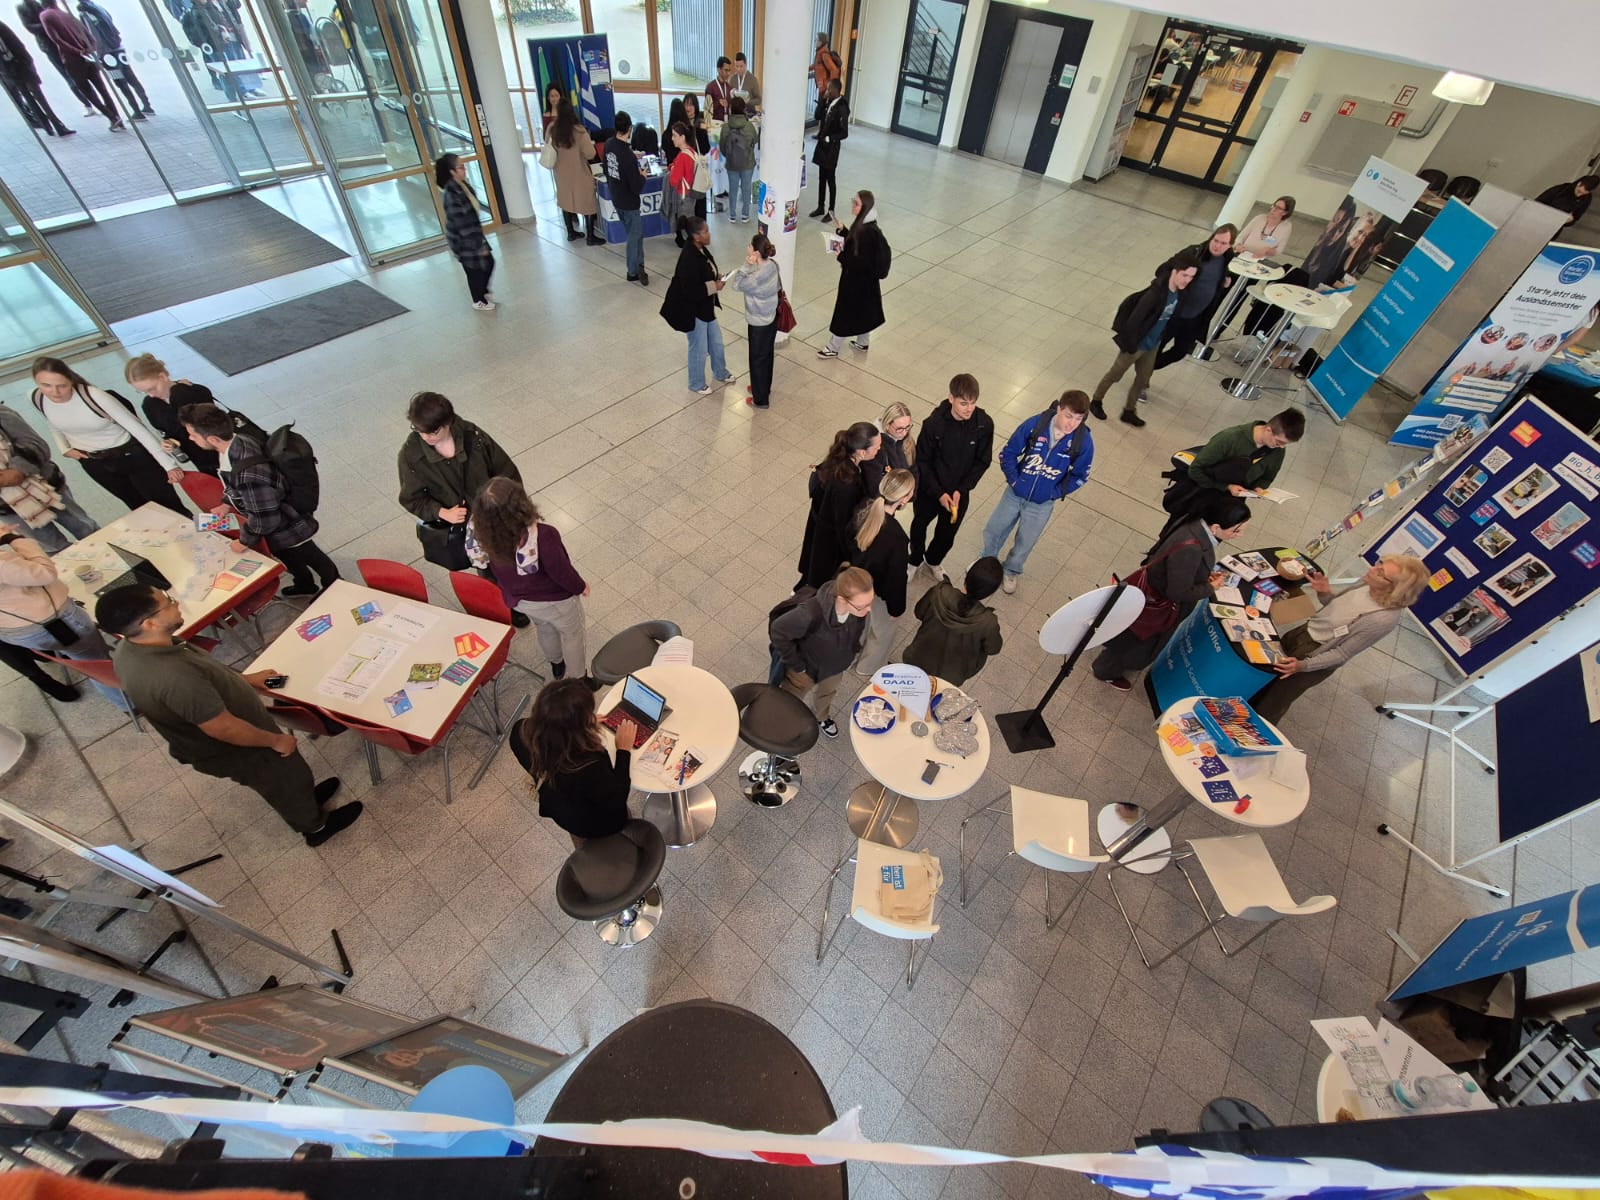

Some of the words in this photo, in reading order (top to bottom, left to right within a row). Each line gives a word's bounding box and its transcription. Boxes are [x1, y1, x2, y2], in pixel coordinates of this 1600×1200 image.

[1526, 285, 1552, 298] Starte
[1549, 289, 1570, 298] jetzt
[1570, 292, 1588, 301] dein
[1516, 295, 1583, 310] Auslandssemester
[1207, 625, 1222, 653] Office
